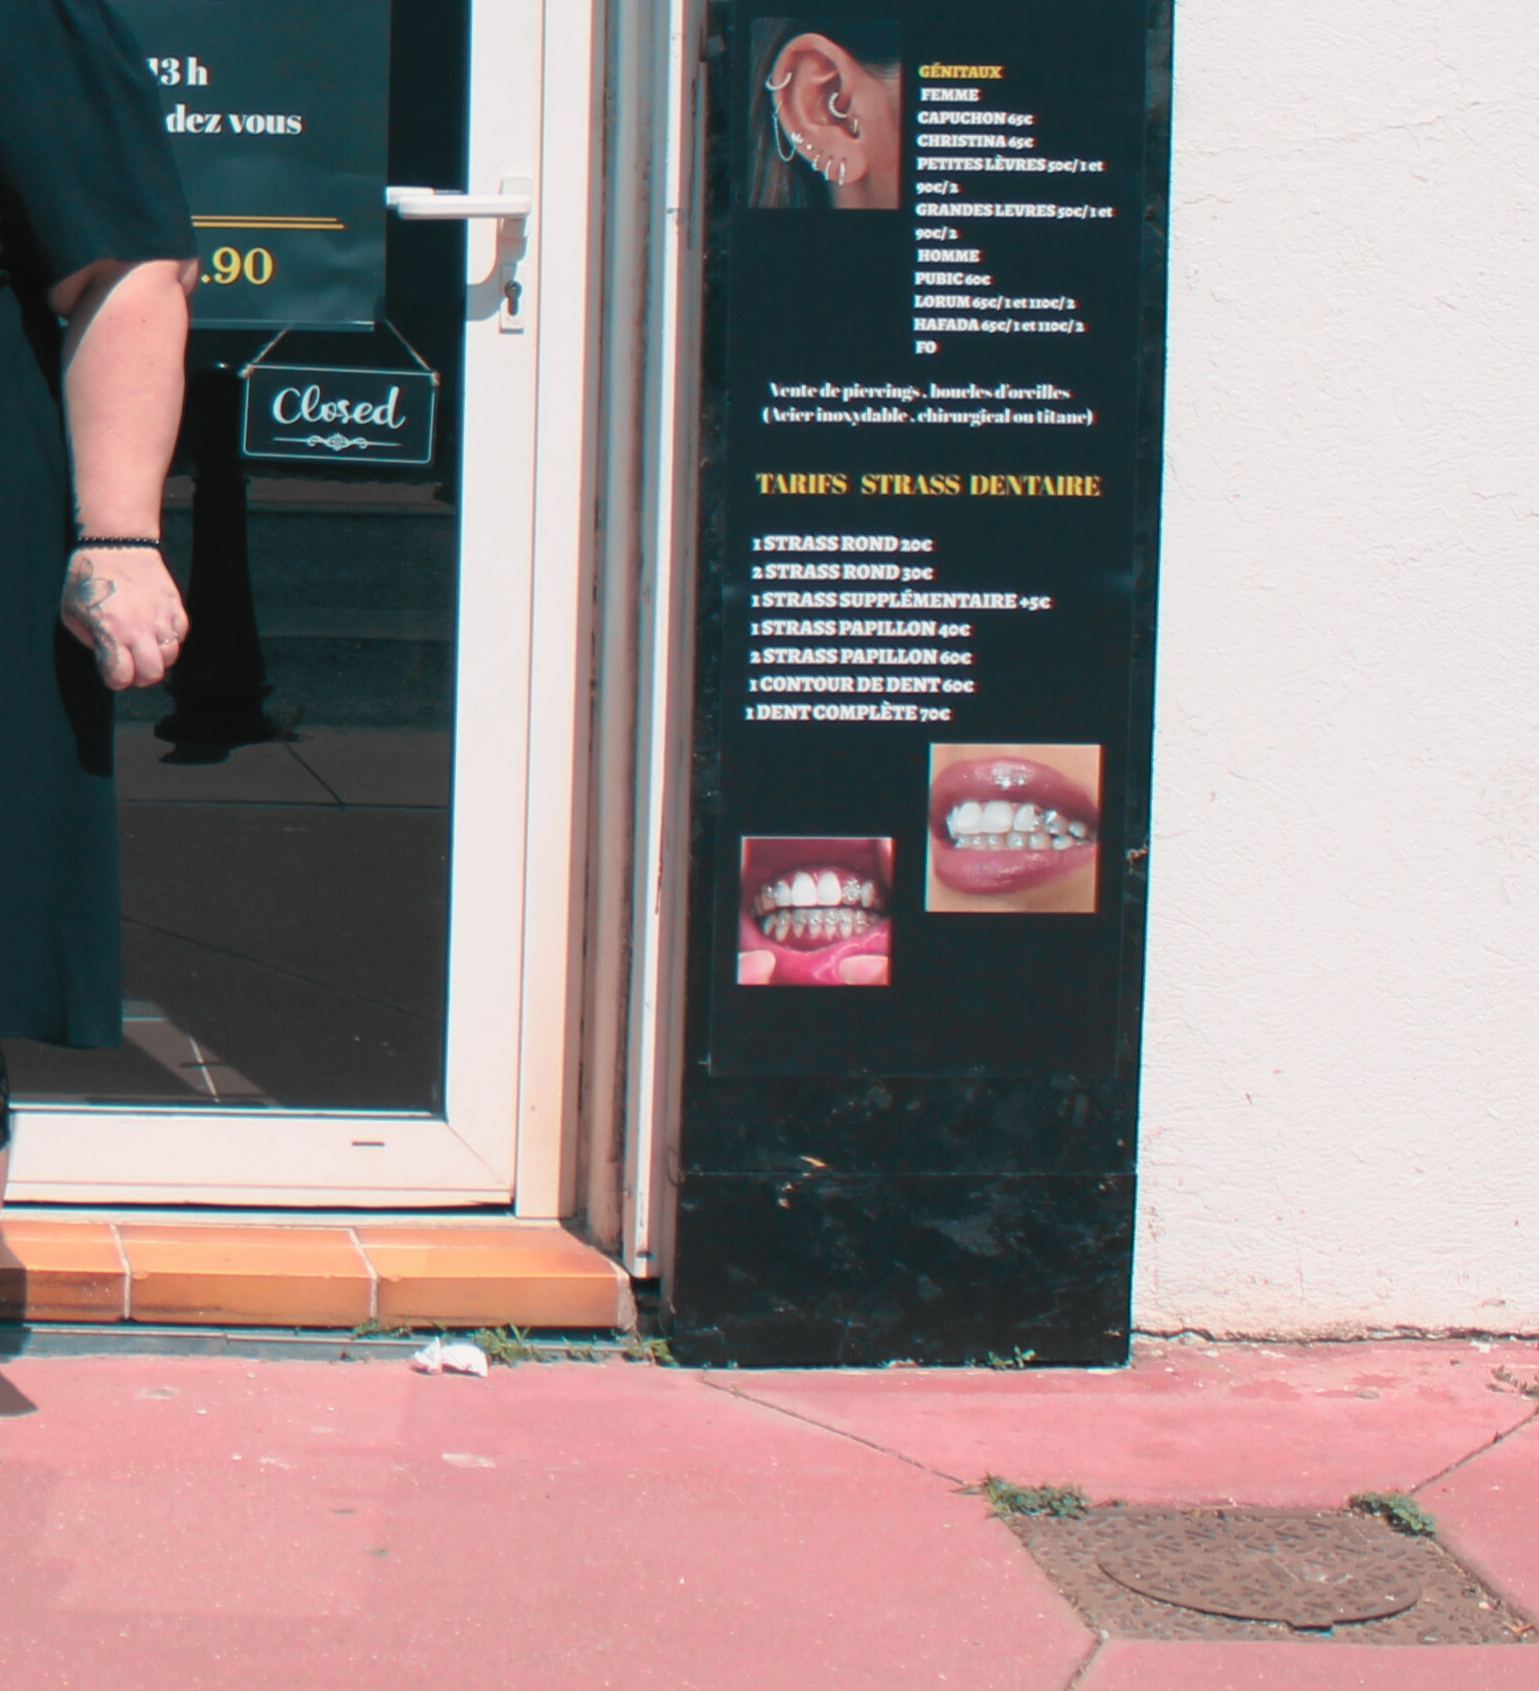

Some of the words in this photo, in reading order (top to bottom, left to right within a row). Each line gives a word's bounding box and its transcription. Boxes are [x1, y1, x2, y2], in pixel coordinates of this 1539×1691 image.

[187, 57, 208, 86] h
[919, 62, 1002, 79] GÉNITAUX
[921, 88, 979, 101] FEMME
[229, 112, 302, 135] vous
[918, 112, 1005, 125] CAPUCHON
[918, 135, 1006, 148] CHRISTINA
[918, 250, 980, 263] HOMME
[915, 272, 963, 286] PUBIC
[273, 386, 405, 429] Closed
[756, 473, 848, 495] TARIFS
[861, 474, 961, 496] STRASS
[971, 475, 1101, 496] DENTAIRE
[764, 536, 838, 551] STRASS
[841, 536, 897, 551] ROND
[758, 705, 811, 721] DENT
[813, 700, 917, 722] COMPLÈTE
